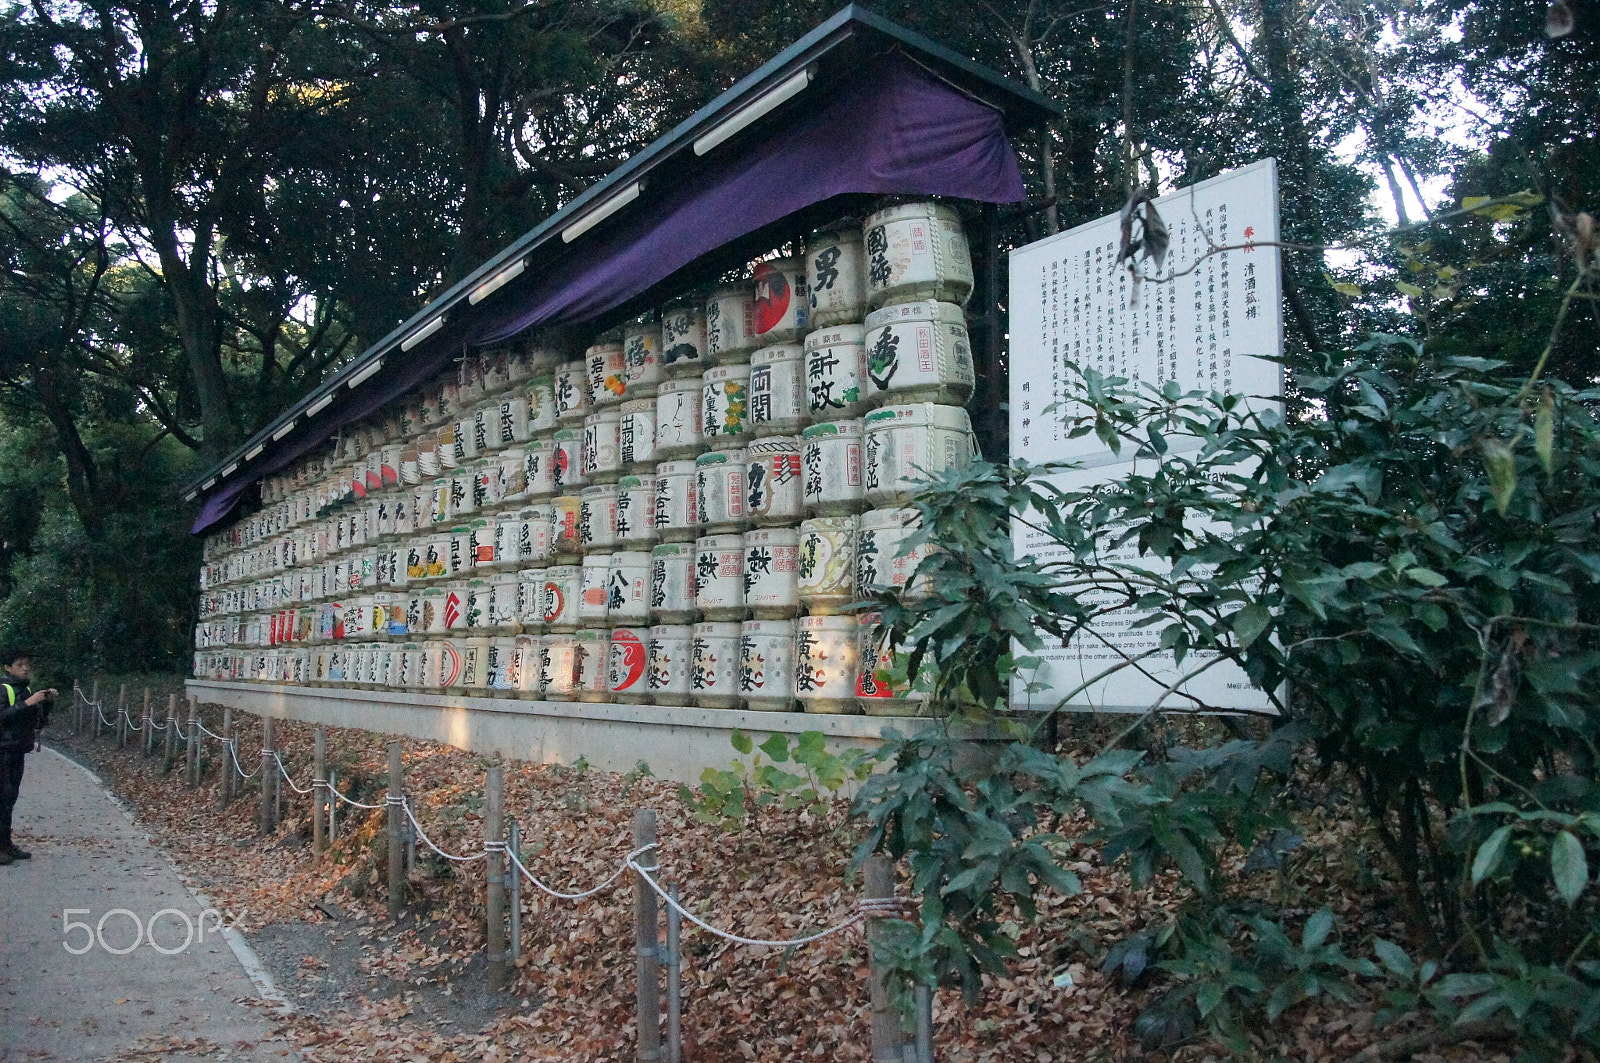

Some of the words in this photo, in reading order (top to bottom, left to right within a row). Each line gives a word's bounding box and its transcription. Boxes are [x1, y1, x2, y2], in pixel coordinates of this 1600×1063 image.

[751, 365, 771, 423] 両関
[808, 349, 846, 411] 新政
[1022, 381, 1030, 447] 明治神宮
[804, 443, 822, 503] 秩父錦
[616, 492, 632, 538] 岩の井
[544, 590, 555, 616] 菊水
